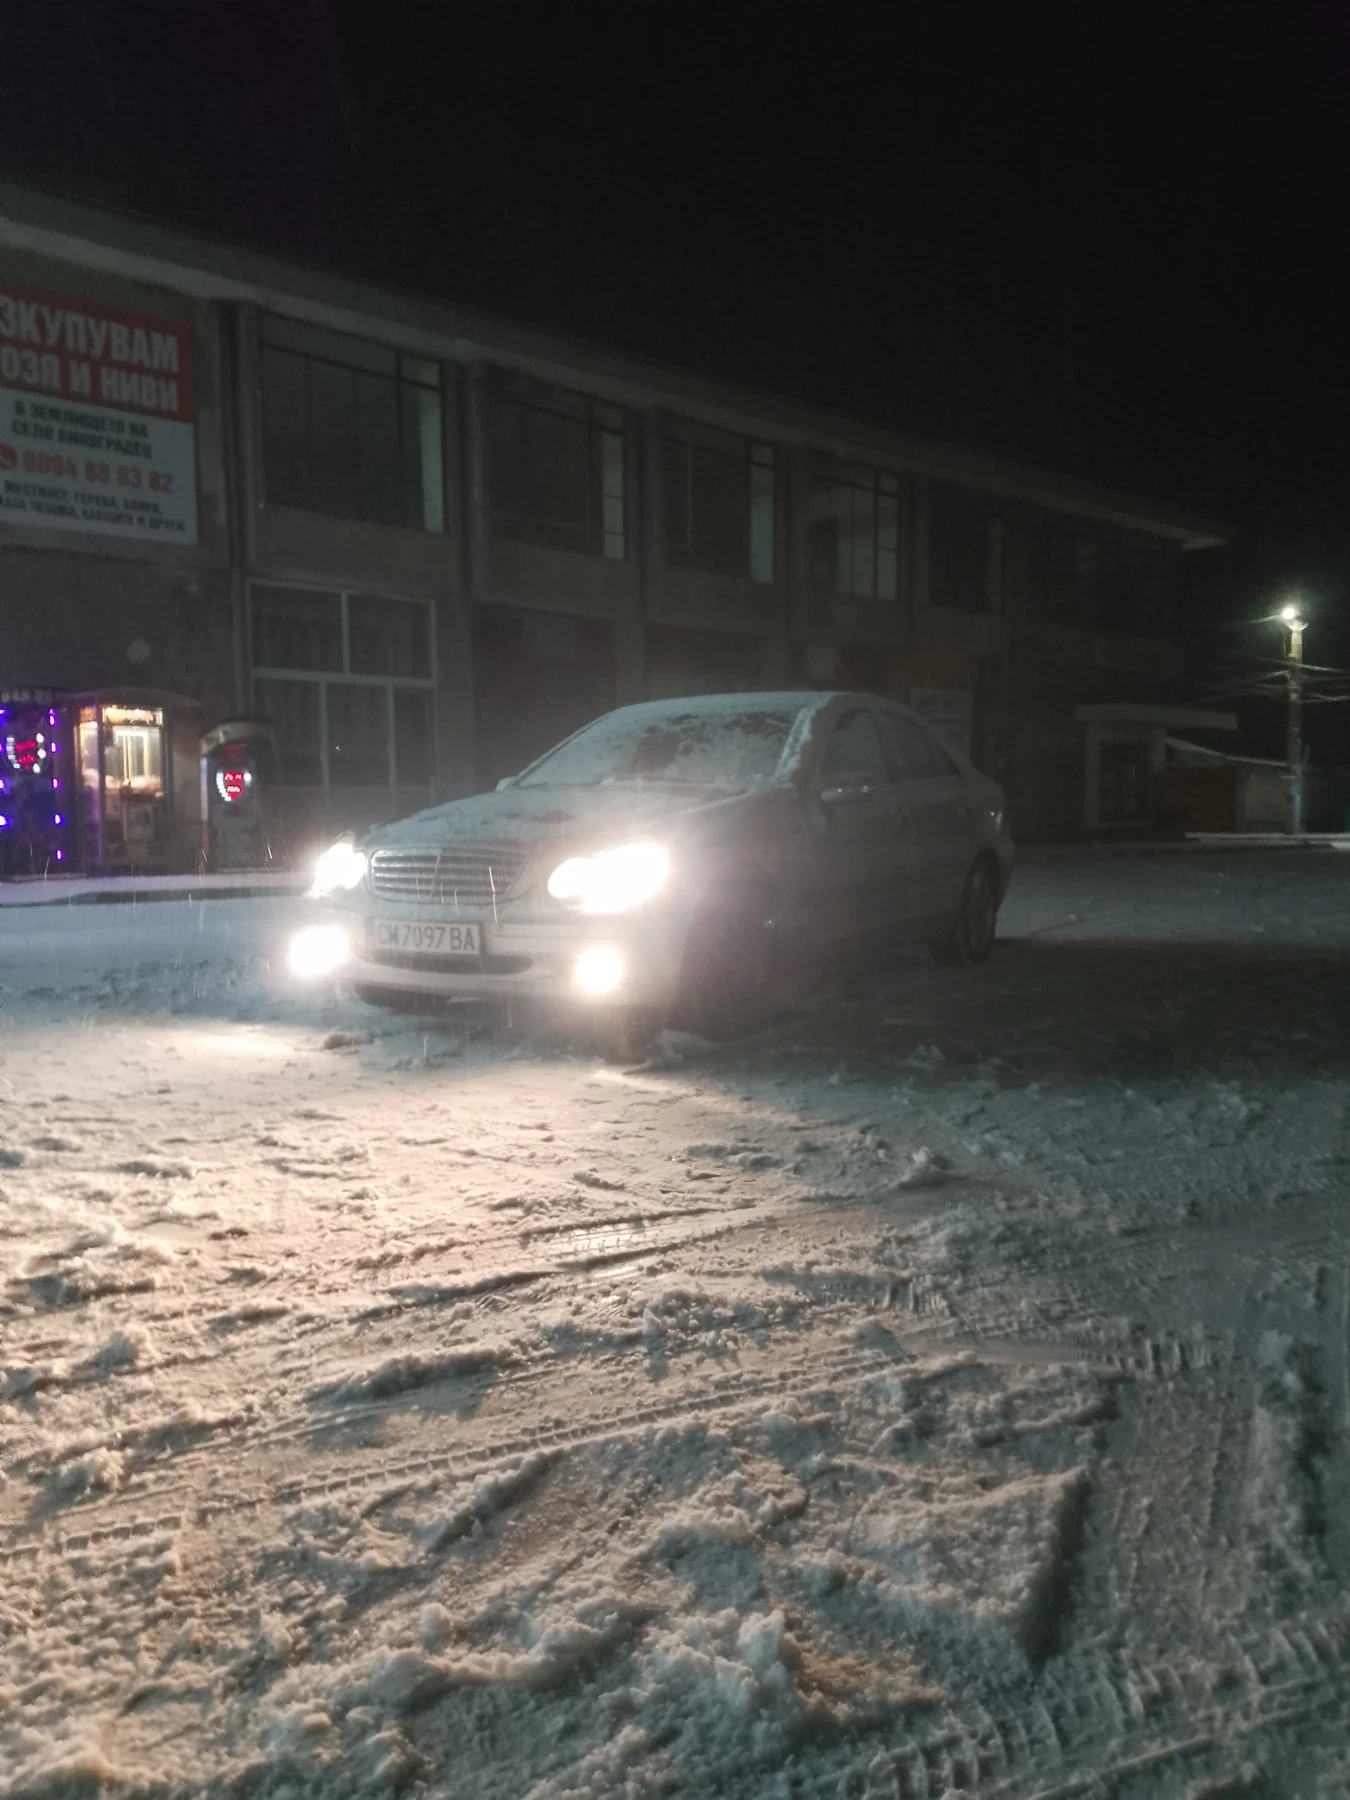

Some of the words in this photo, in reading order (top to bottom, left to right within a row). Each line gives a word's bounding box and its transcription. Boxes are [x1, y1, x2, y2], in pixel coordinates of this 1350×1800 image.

[69, 359, 92, 397] И
[101, 365, 178, 413] НИВИ
[12, 419, 54, 441] СЕЛО
[128, 420, 149, 439] НА
